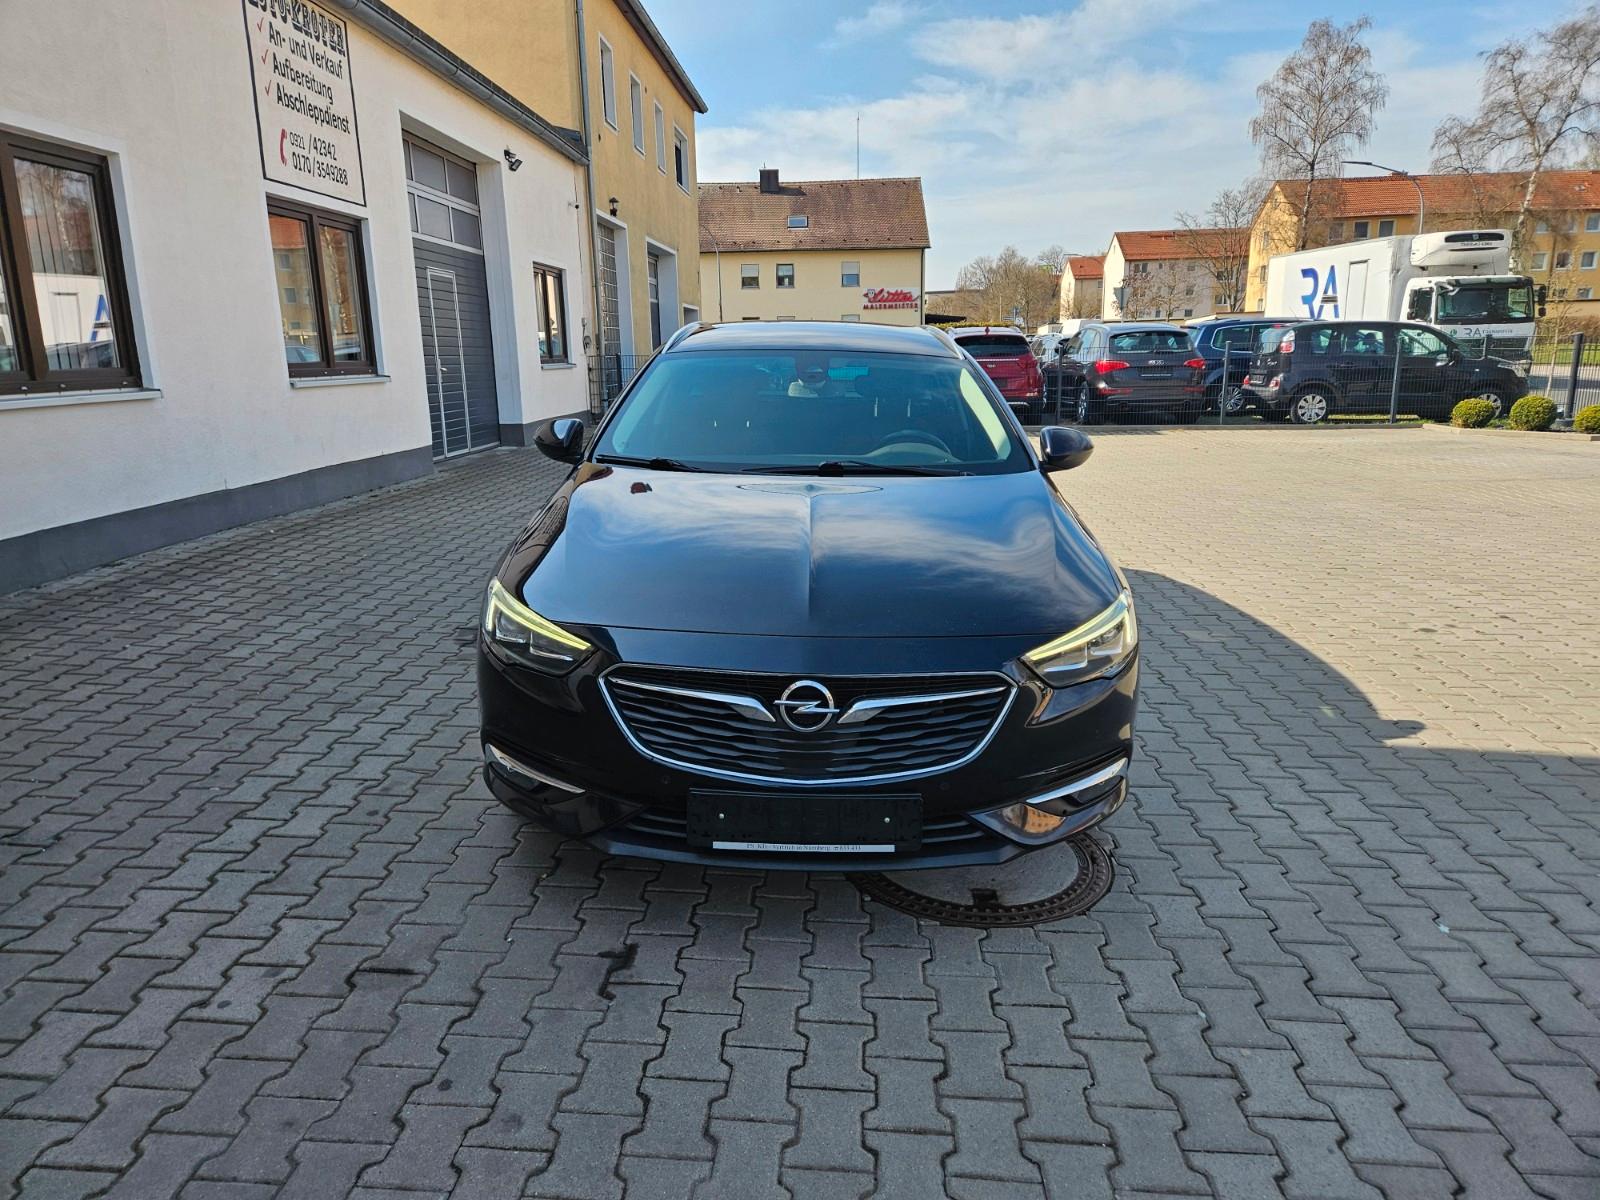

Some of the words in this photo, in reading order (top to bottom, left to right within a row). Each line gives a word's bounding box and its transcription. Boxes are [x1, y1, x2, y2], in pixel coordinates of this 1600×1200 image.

[269, 21, 286, 48] An-
[289, 36, 308, 60] und
[307, 43, 343, 79] Verkauf
[272, 52, 333, 105] Aufbereitung
[276, 82, 351, 134] Abschleppdienst
